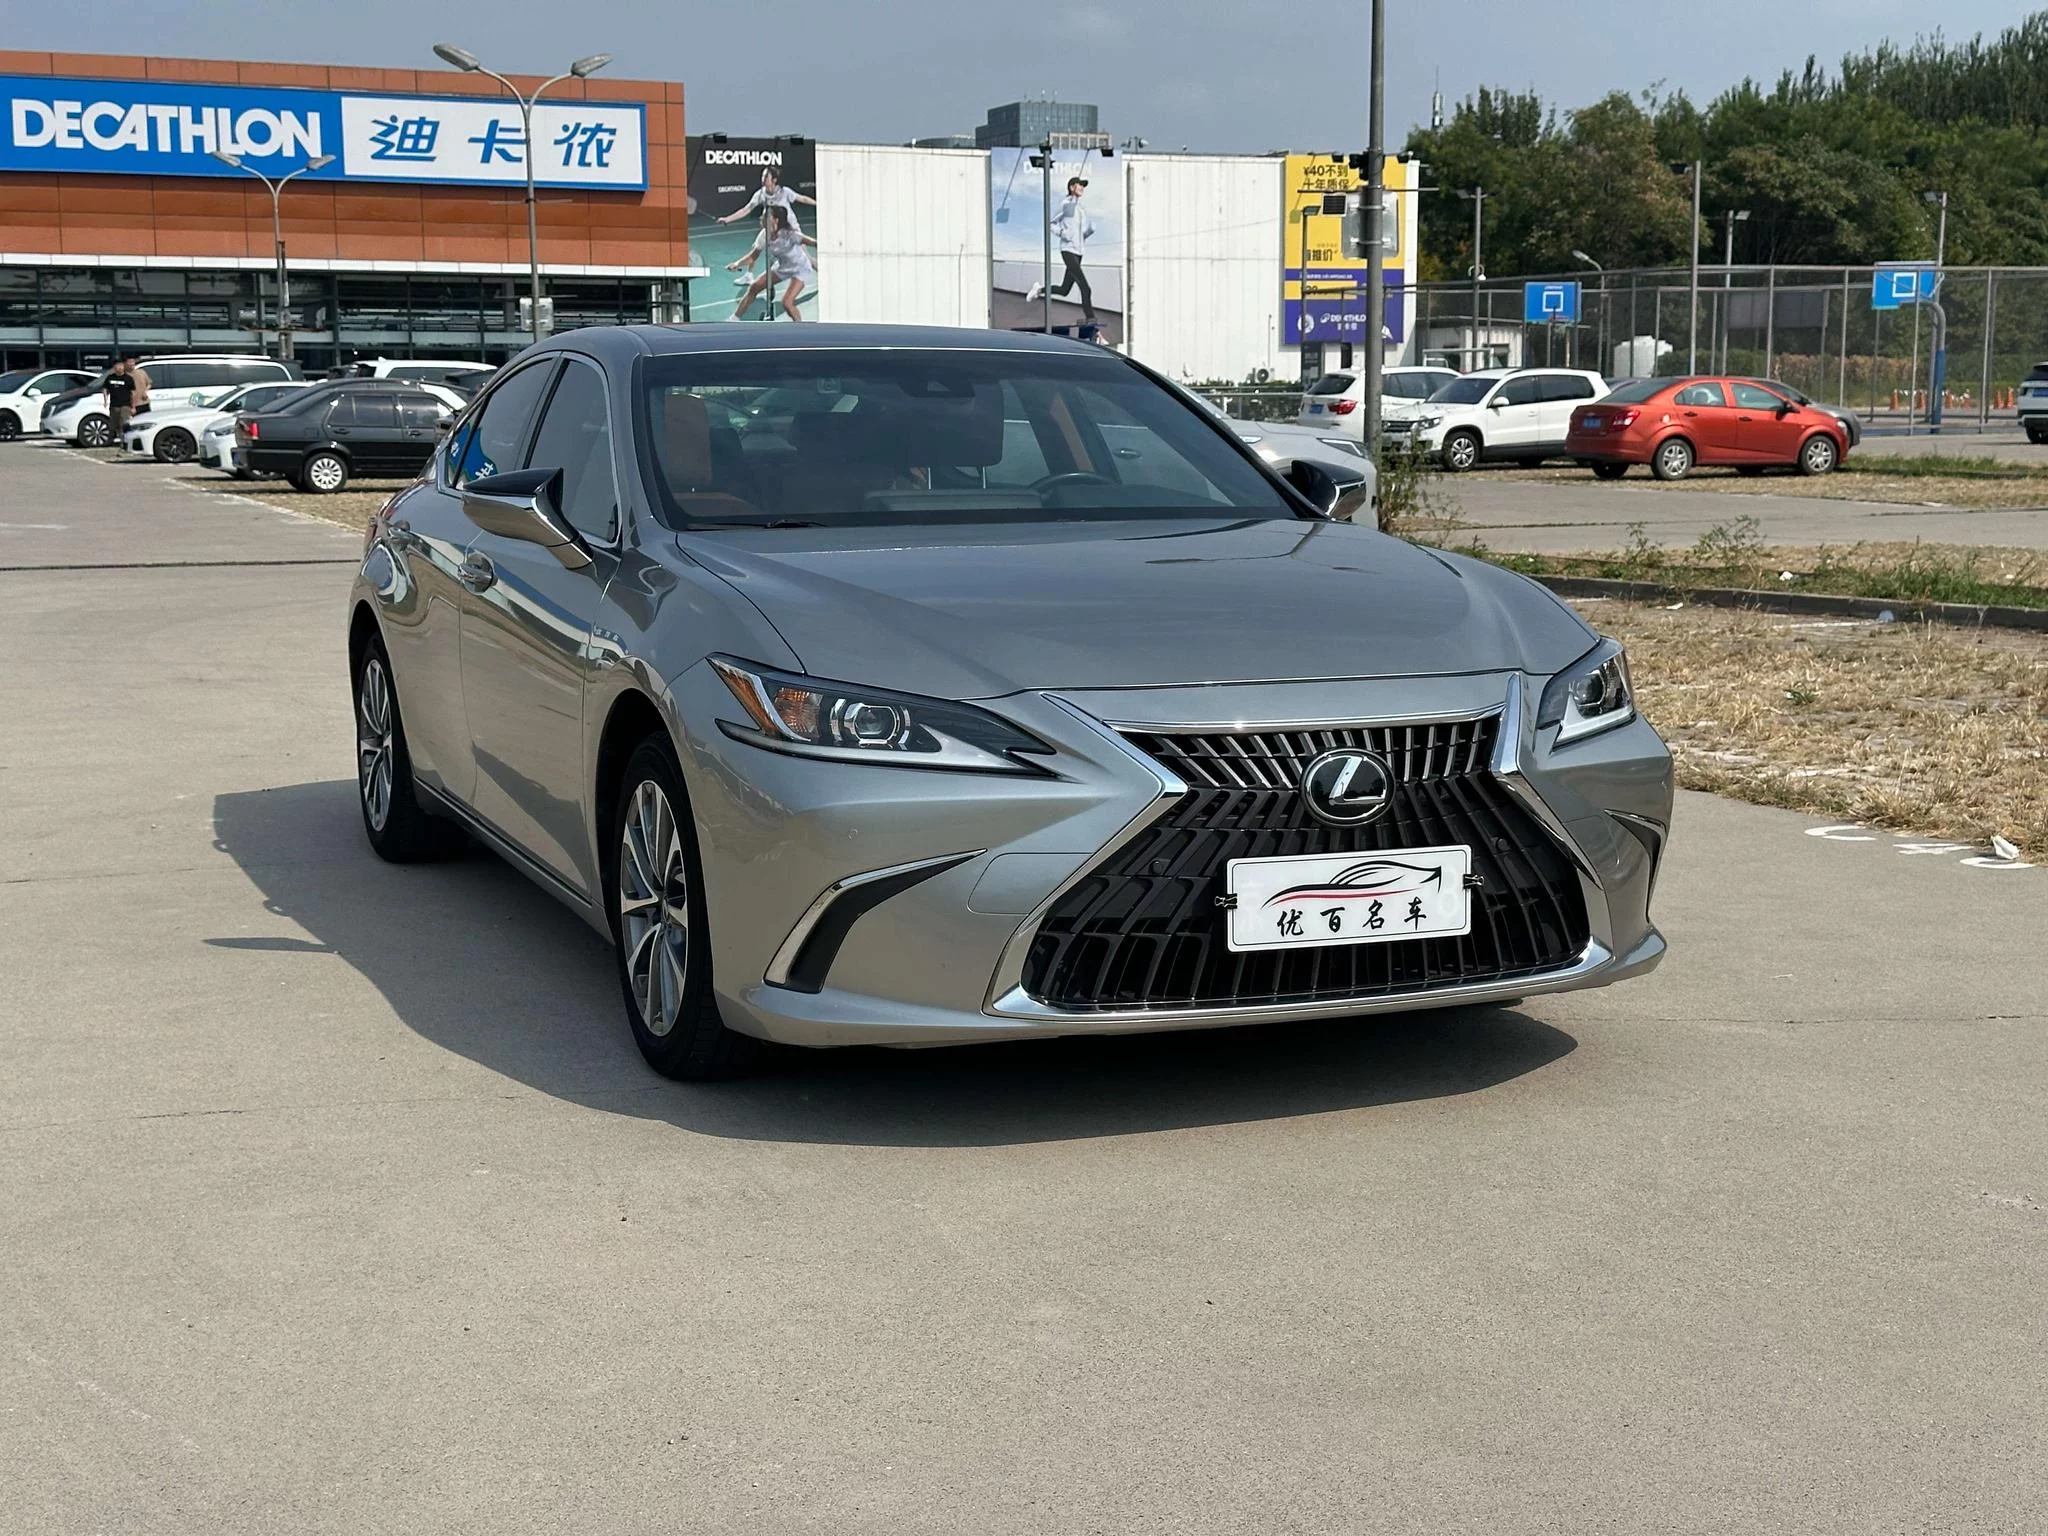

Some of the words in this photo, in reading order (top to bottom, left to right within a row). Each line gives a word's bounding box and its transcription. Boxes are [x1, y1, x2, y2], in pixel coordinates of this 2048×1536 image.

[11, 98, 322, 158] DECATHLON
[369, 115, 617, 168] 迪卡侬
[705, 150, 782, 166] DECATHLON
[1276, 896, 1427, 937] 优百名车
